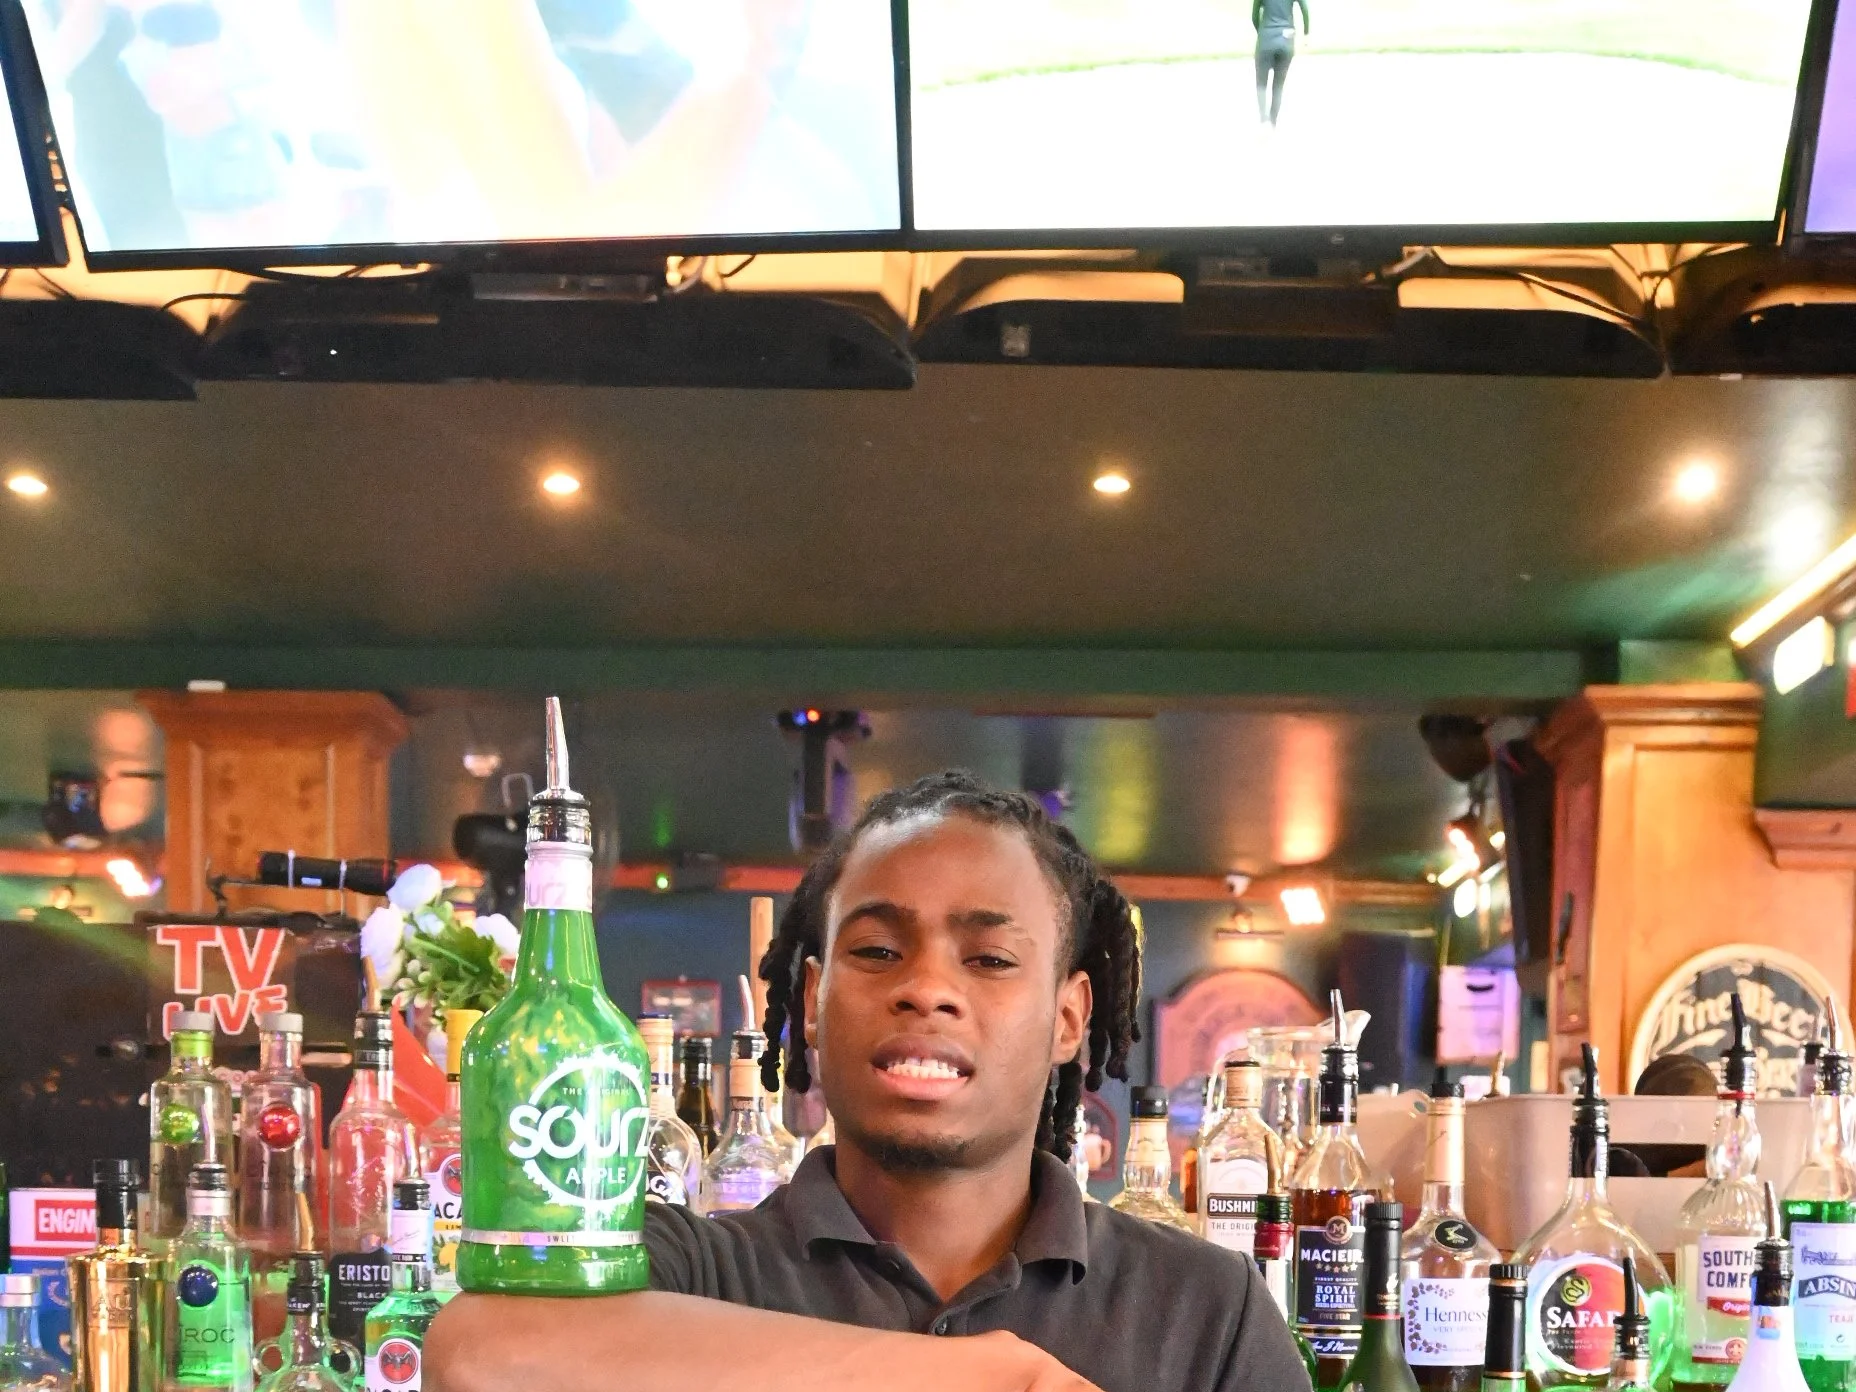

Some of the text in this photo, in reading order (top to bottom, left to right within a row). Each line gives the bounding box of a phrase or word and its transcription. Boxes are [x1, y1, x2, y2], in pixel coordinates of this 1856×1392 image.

[156, 925, 286, 994] TV
[565, 1168, 627, 1185] APLE
[1212, 1222, 1226, 1230] THE
[338, 1264, 391, 1281] ERISTO
[1316, 1285, 1356, 1295] ROYAL
[1315, 1294, 1356, 1303] SPIRIT
